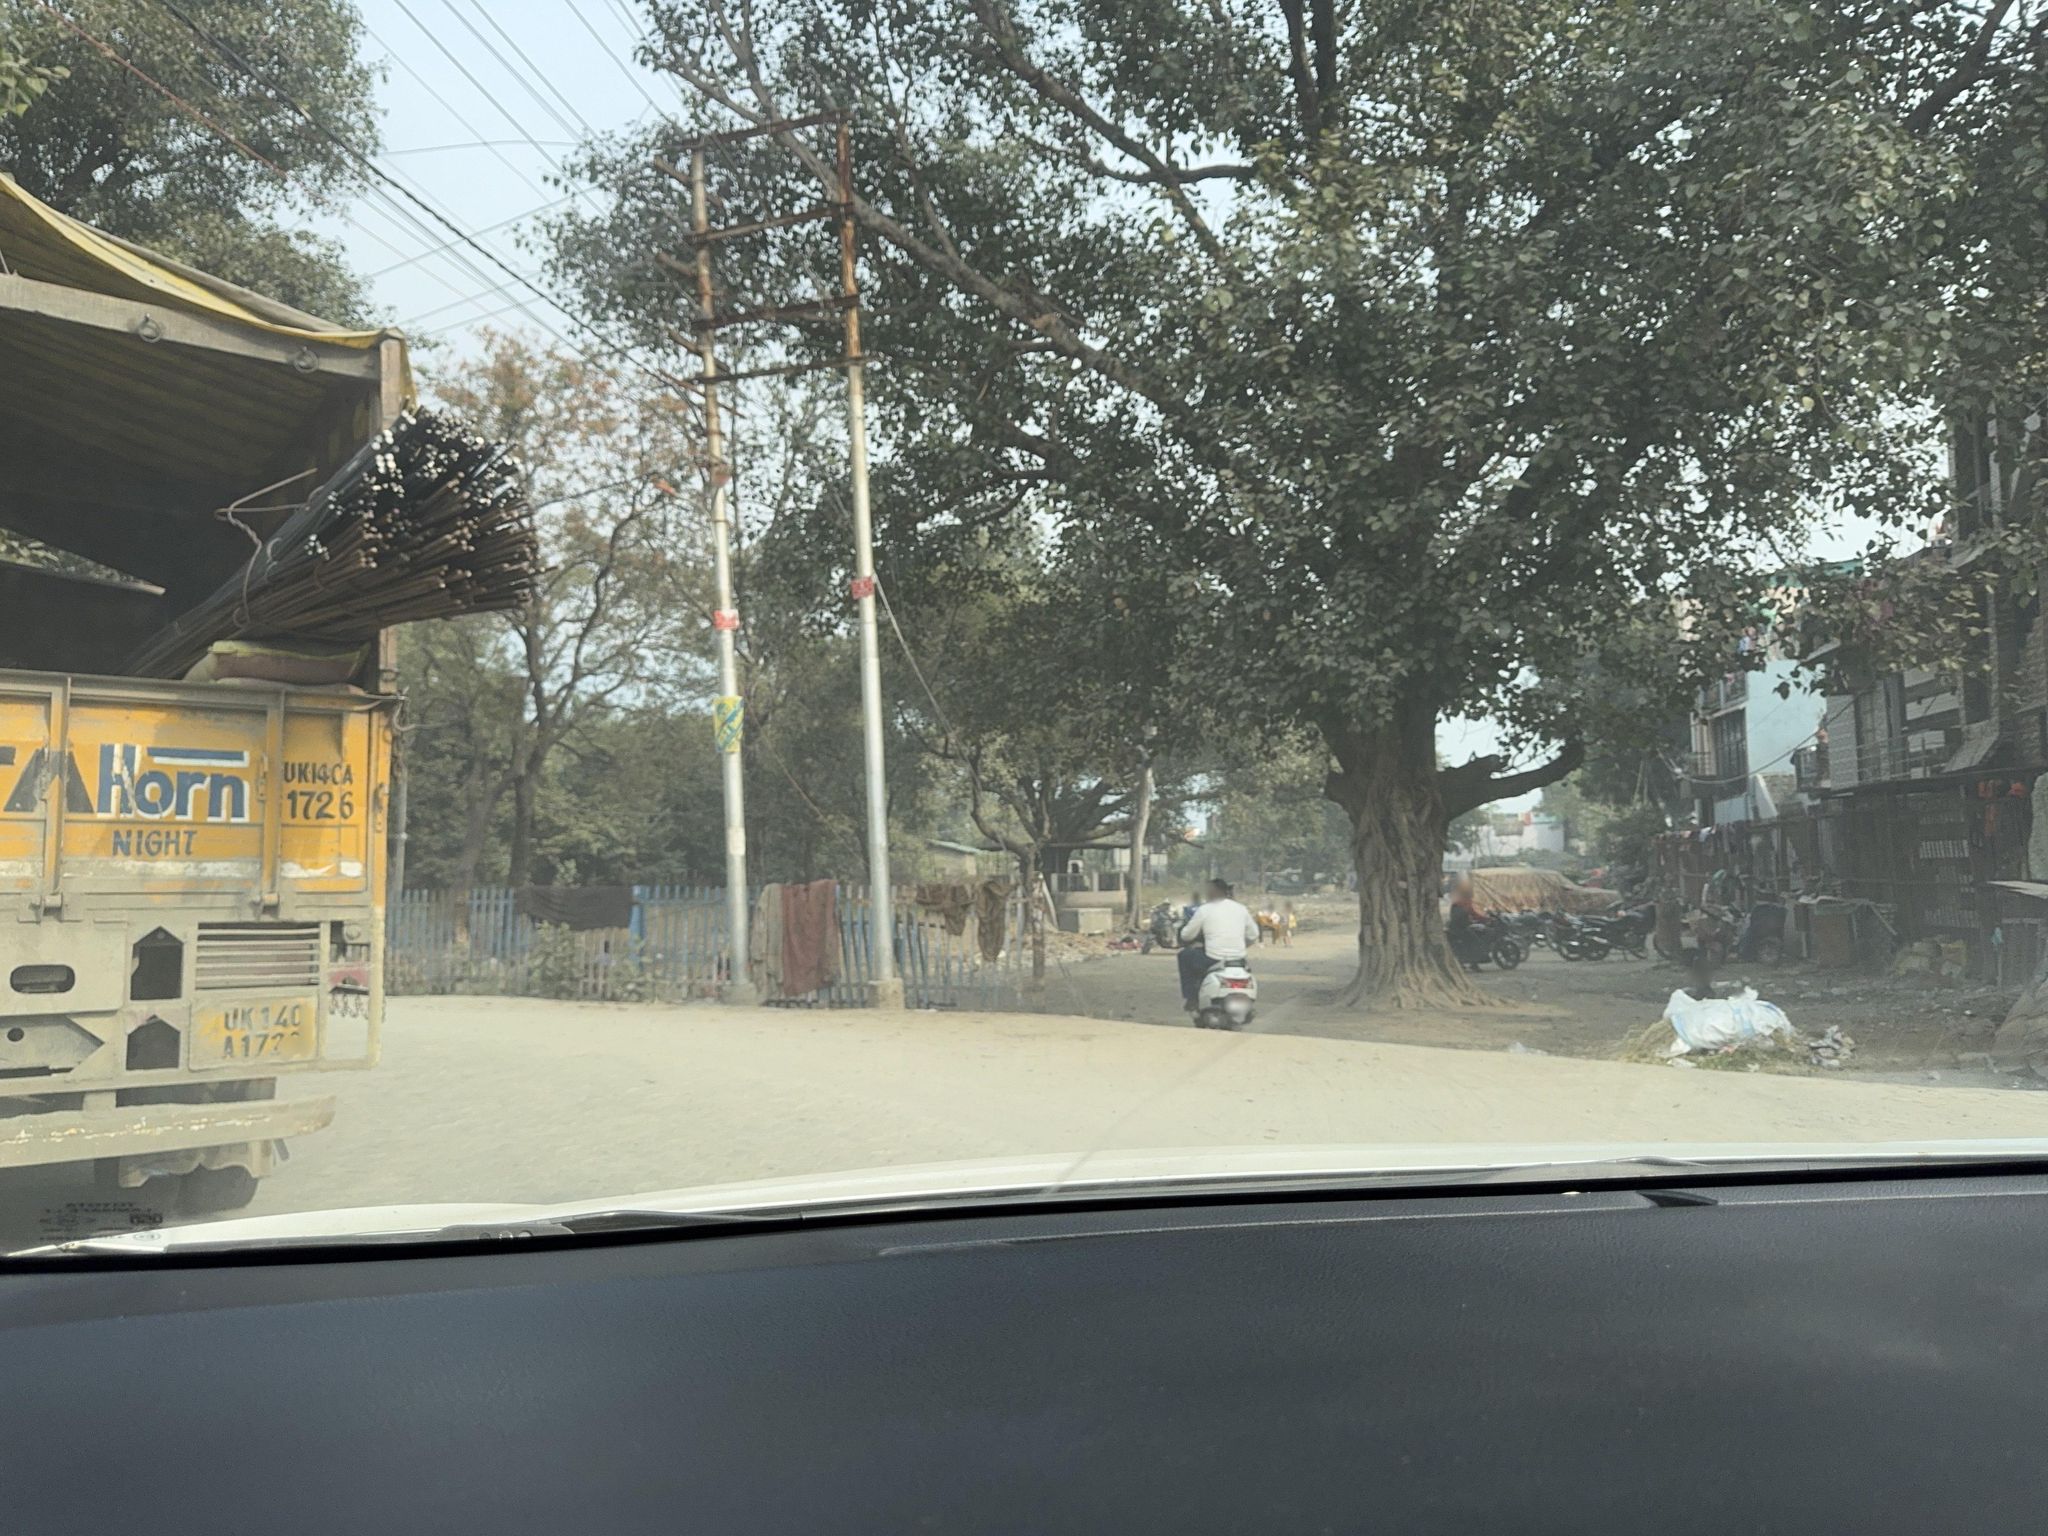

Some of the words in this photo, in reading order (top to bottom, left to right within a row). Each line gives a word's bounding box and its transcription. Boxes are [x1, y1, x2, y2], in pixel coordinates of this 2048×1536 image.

[97, 744, 249, 823] Horn
[287, 790, 354, 820] 1726
[112, 830, 197, 857] NIGHT
